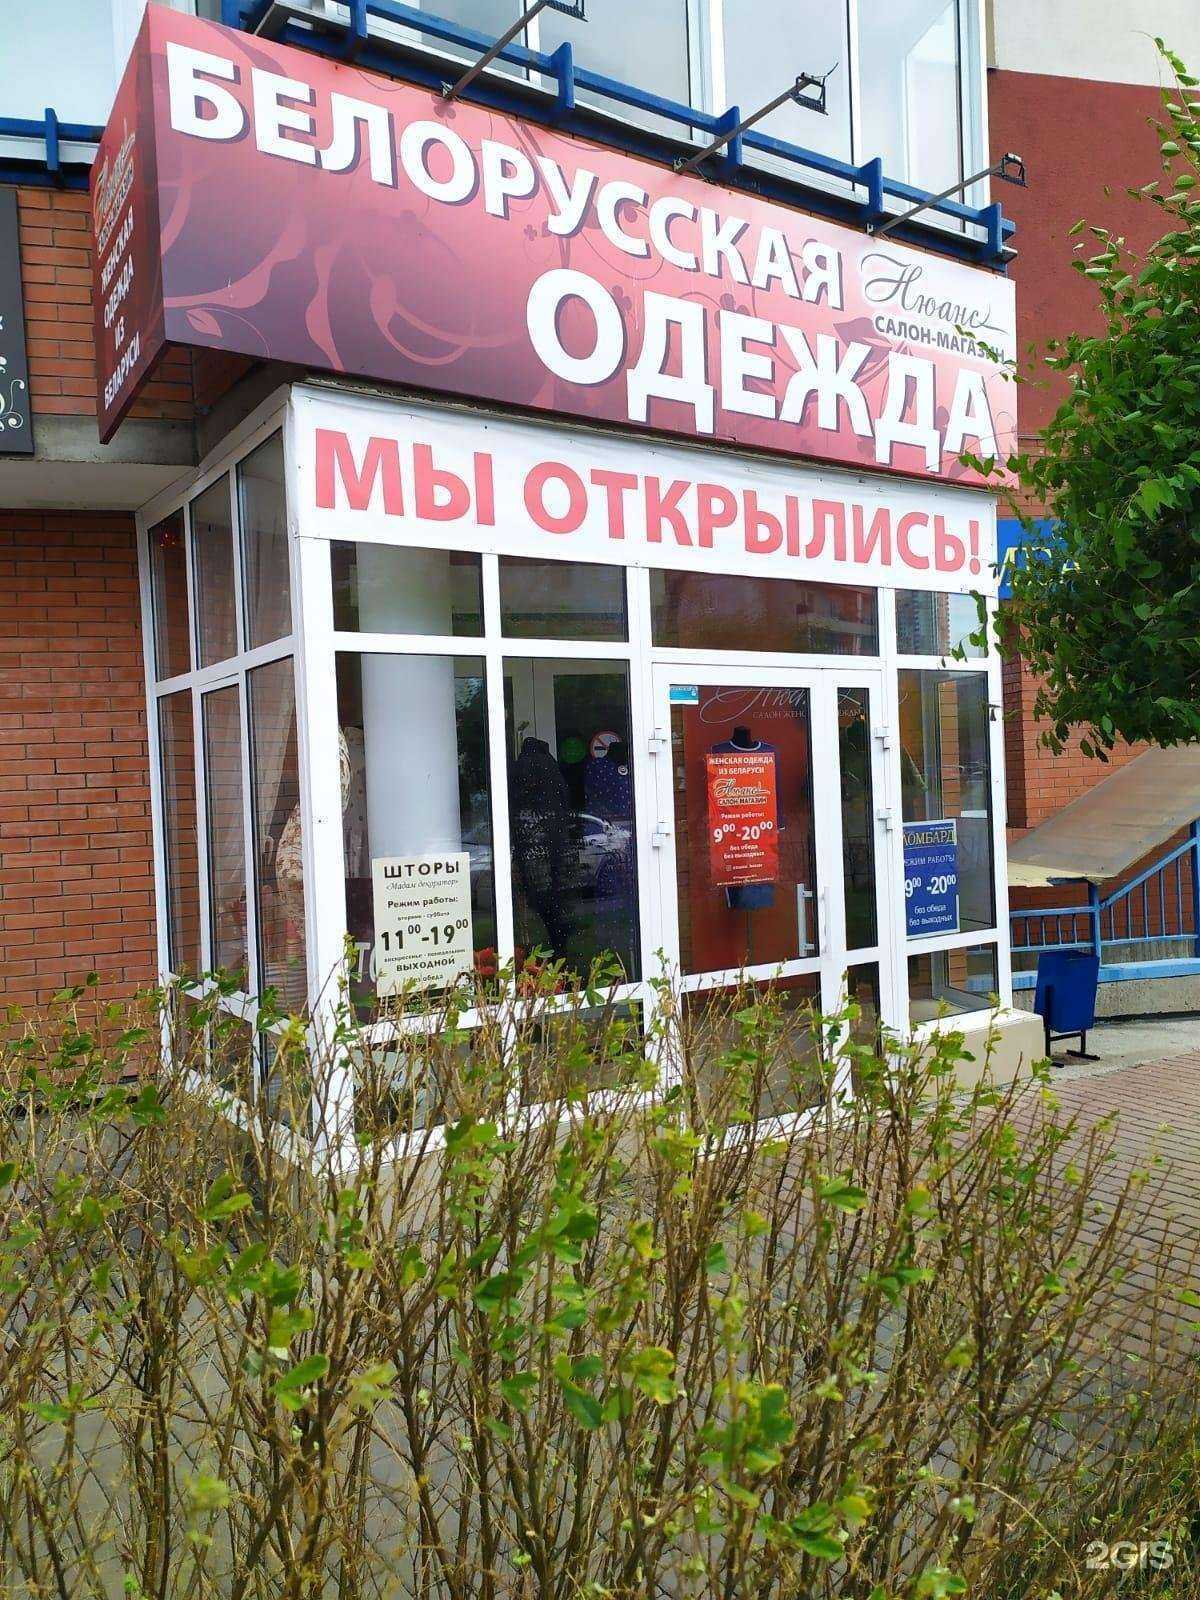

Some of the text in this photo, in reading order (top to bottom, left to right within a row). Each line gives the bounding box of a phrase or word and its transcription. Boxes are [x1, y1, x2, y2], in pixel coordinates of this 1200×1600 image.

[166, 41, 843, 309] БЕЛОРУССКАЯ
[101, 204, 134, 295] ЖЕНСКАЯ
[104, 254, 134, 328] ОДЕЖДА
[860, 253, 1009, 335] Нюанс
[115, 316, 125, 350] ИЗ
[875, 316, 1005, 362] САЛОН-МАГАЗН
[104, 331, 140, 410] БЕЛАРУСИ
[527, 268, 998, 474] ОДЕЖДА
[315, 428, 495, 527] МЫ
[523, 461, 980, 576] ОТКРЫЛИСЬ!
[709, 756, 774, 765] ЖЕНСКАЯ ОДЕЖДА
[729, 767, 765, 775] БЕЛАРУСИ
[384, 861, 459, 879] ШТОРЫ
[904, 856, 926, 867] ЕЖИМ
[387, 896, 458, 909] Режим работы:
[915, 905, 926, 914] без
[909, 918, 920, 927] без
[396, 955, 455, 971] ВЫХОДНОЙ
